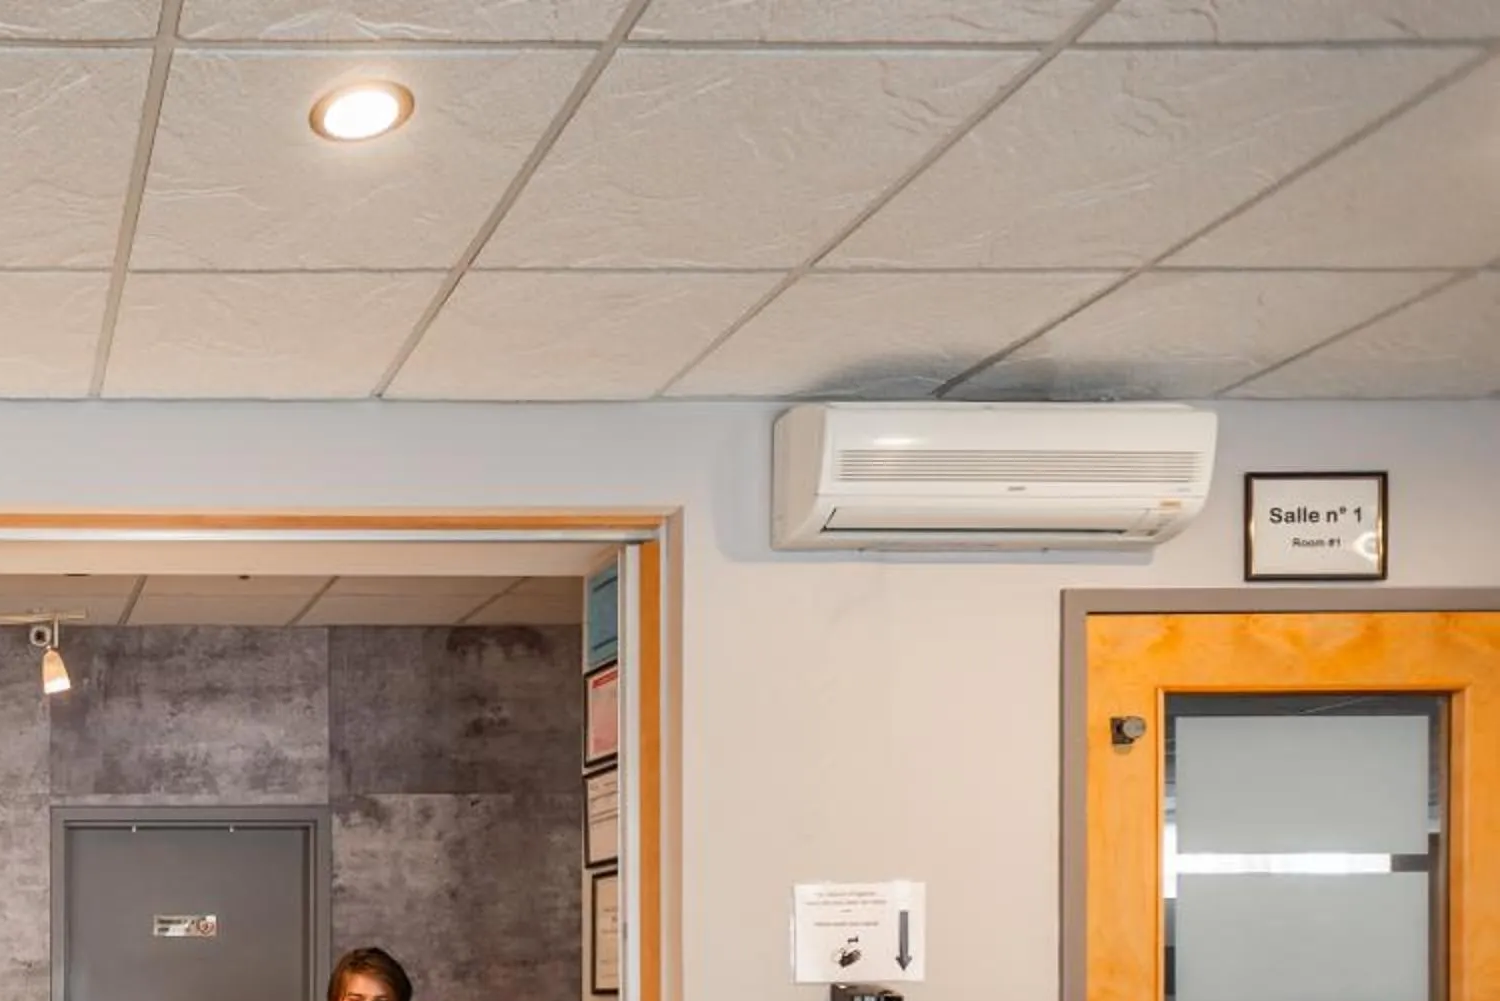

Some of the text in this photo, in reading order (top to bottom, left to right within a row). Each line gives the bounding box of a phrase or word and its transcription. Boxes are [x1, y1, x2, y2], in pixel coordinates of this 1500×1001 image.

[1269, 506, 1362, 524] Salle n° 1
[1292, 537, 1342, 548] Room #1
